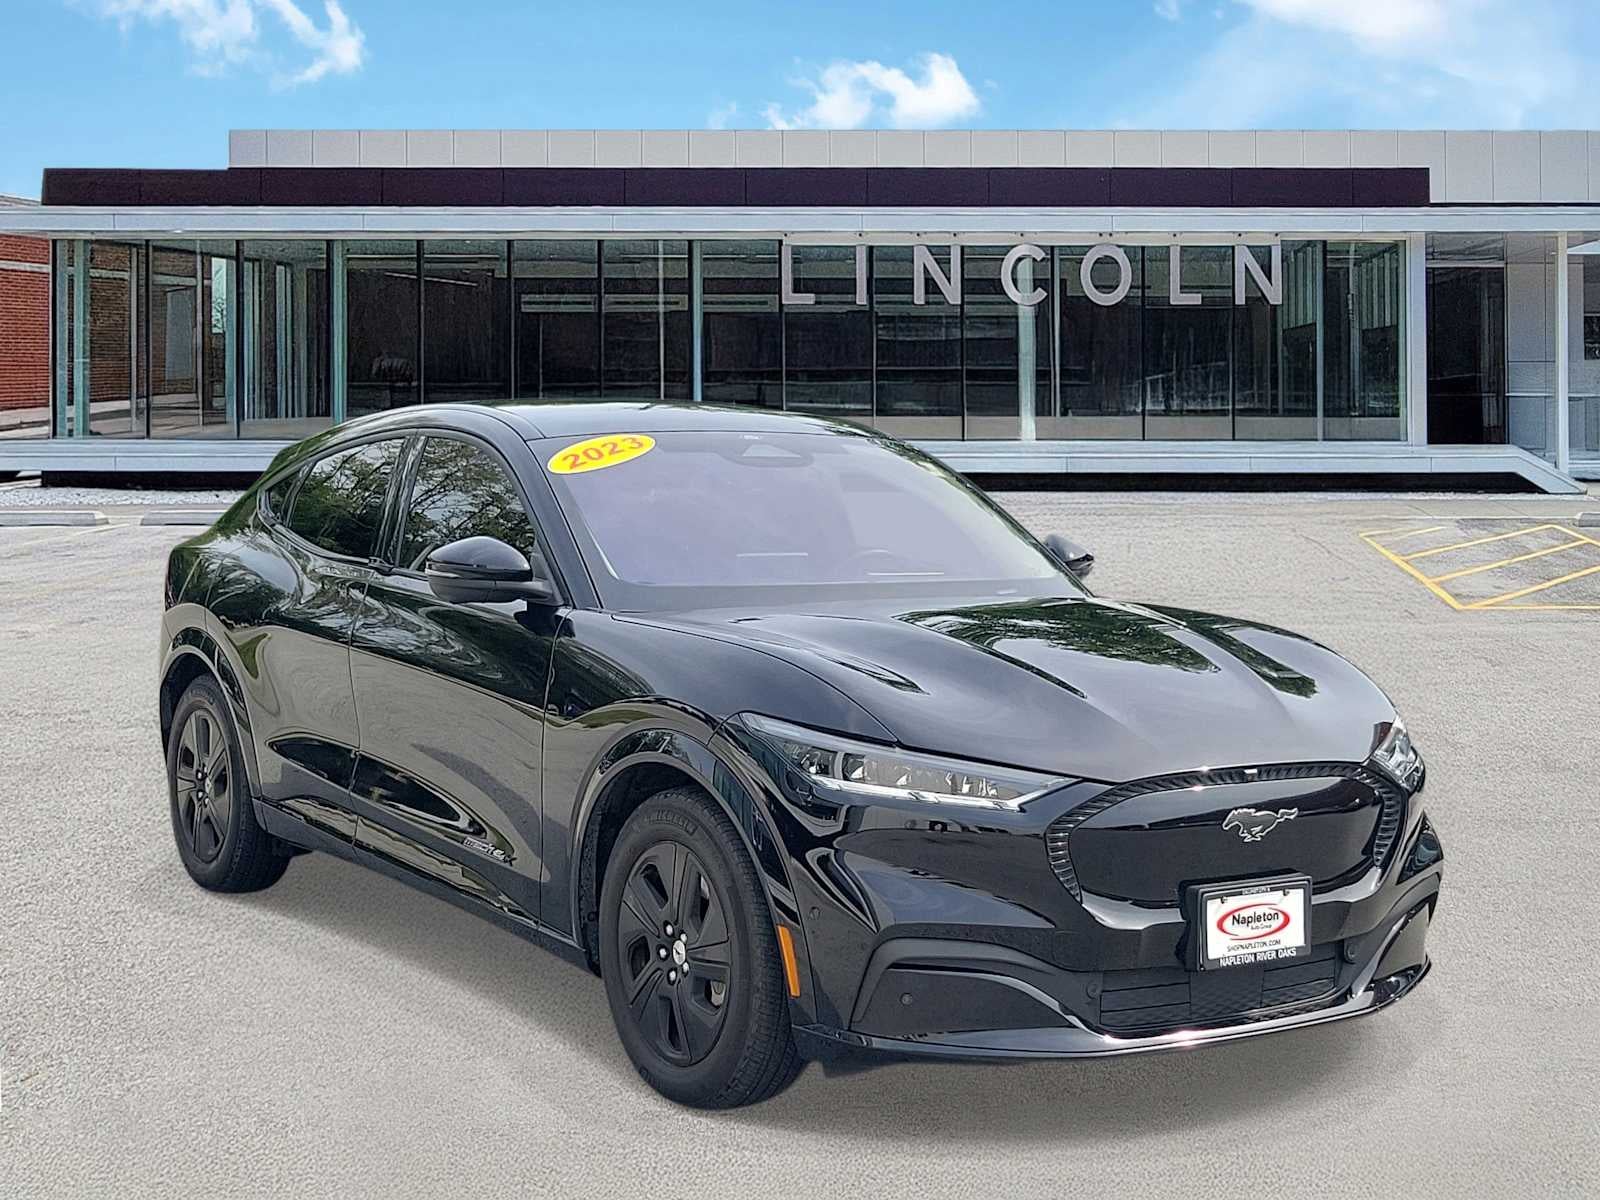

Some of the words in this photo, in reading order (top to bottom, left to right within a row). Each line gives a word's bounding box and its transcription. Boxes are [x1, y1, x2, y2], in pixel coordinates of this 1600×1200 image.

[781, 244, 1283, 307] LINCOLN
[562, 437, 644, 470] 2023
[1232, 911, 1279, 927] Napleton
[1219, 953, 1255, 967] NAPLETON
[1256, 950, 1277, 961] RIVER
[1277, 947, 1297, 957] OAKS
